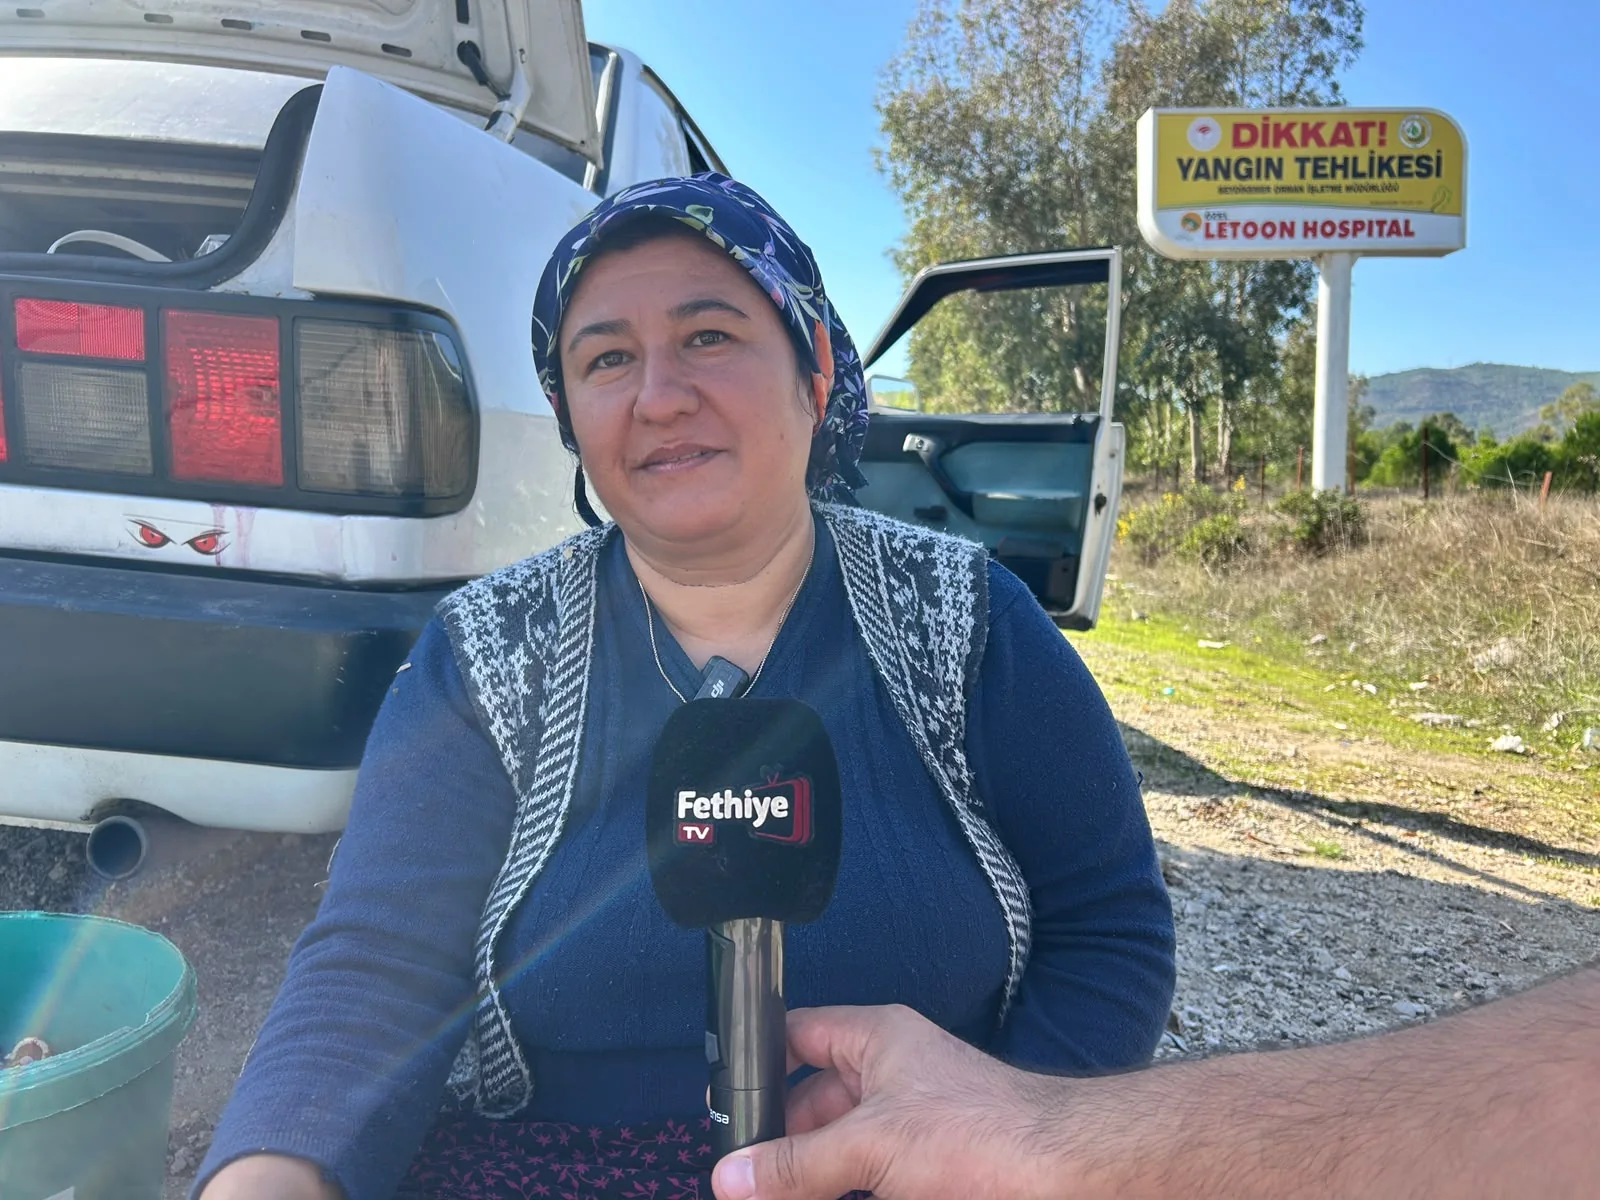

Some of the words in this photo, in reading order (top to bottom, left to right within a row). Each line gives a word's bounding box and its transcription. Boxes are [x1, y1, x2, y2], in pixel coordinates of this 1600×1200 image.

[1231, 116, 1388, 149] DİKKAT!
[1177, 156, 1284, 182] YANGIN
[1294, 149, 1442, 180] TEHLİKESİ
[1204, 221, 1296, 240] LETOON
[1303, 219, 1416, 239] HOSPITAL
[677, 789, 789, 828] Fethiye
[682, 826, 710, 840] TV
